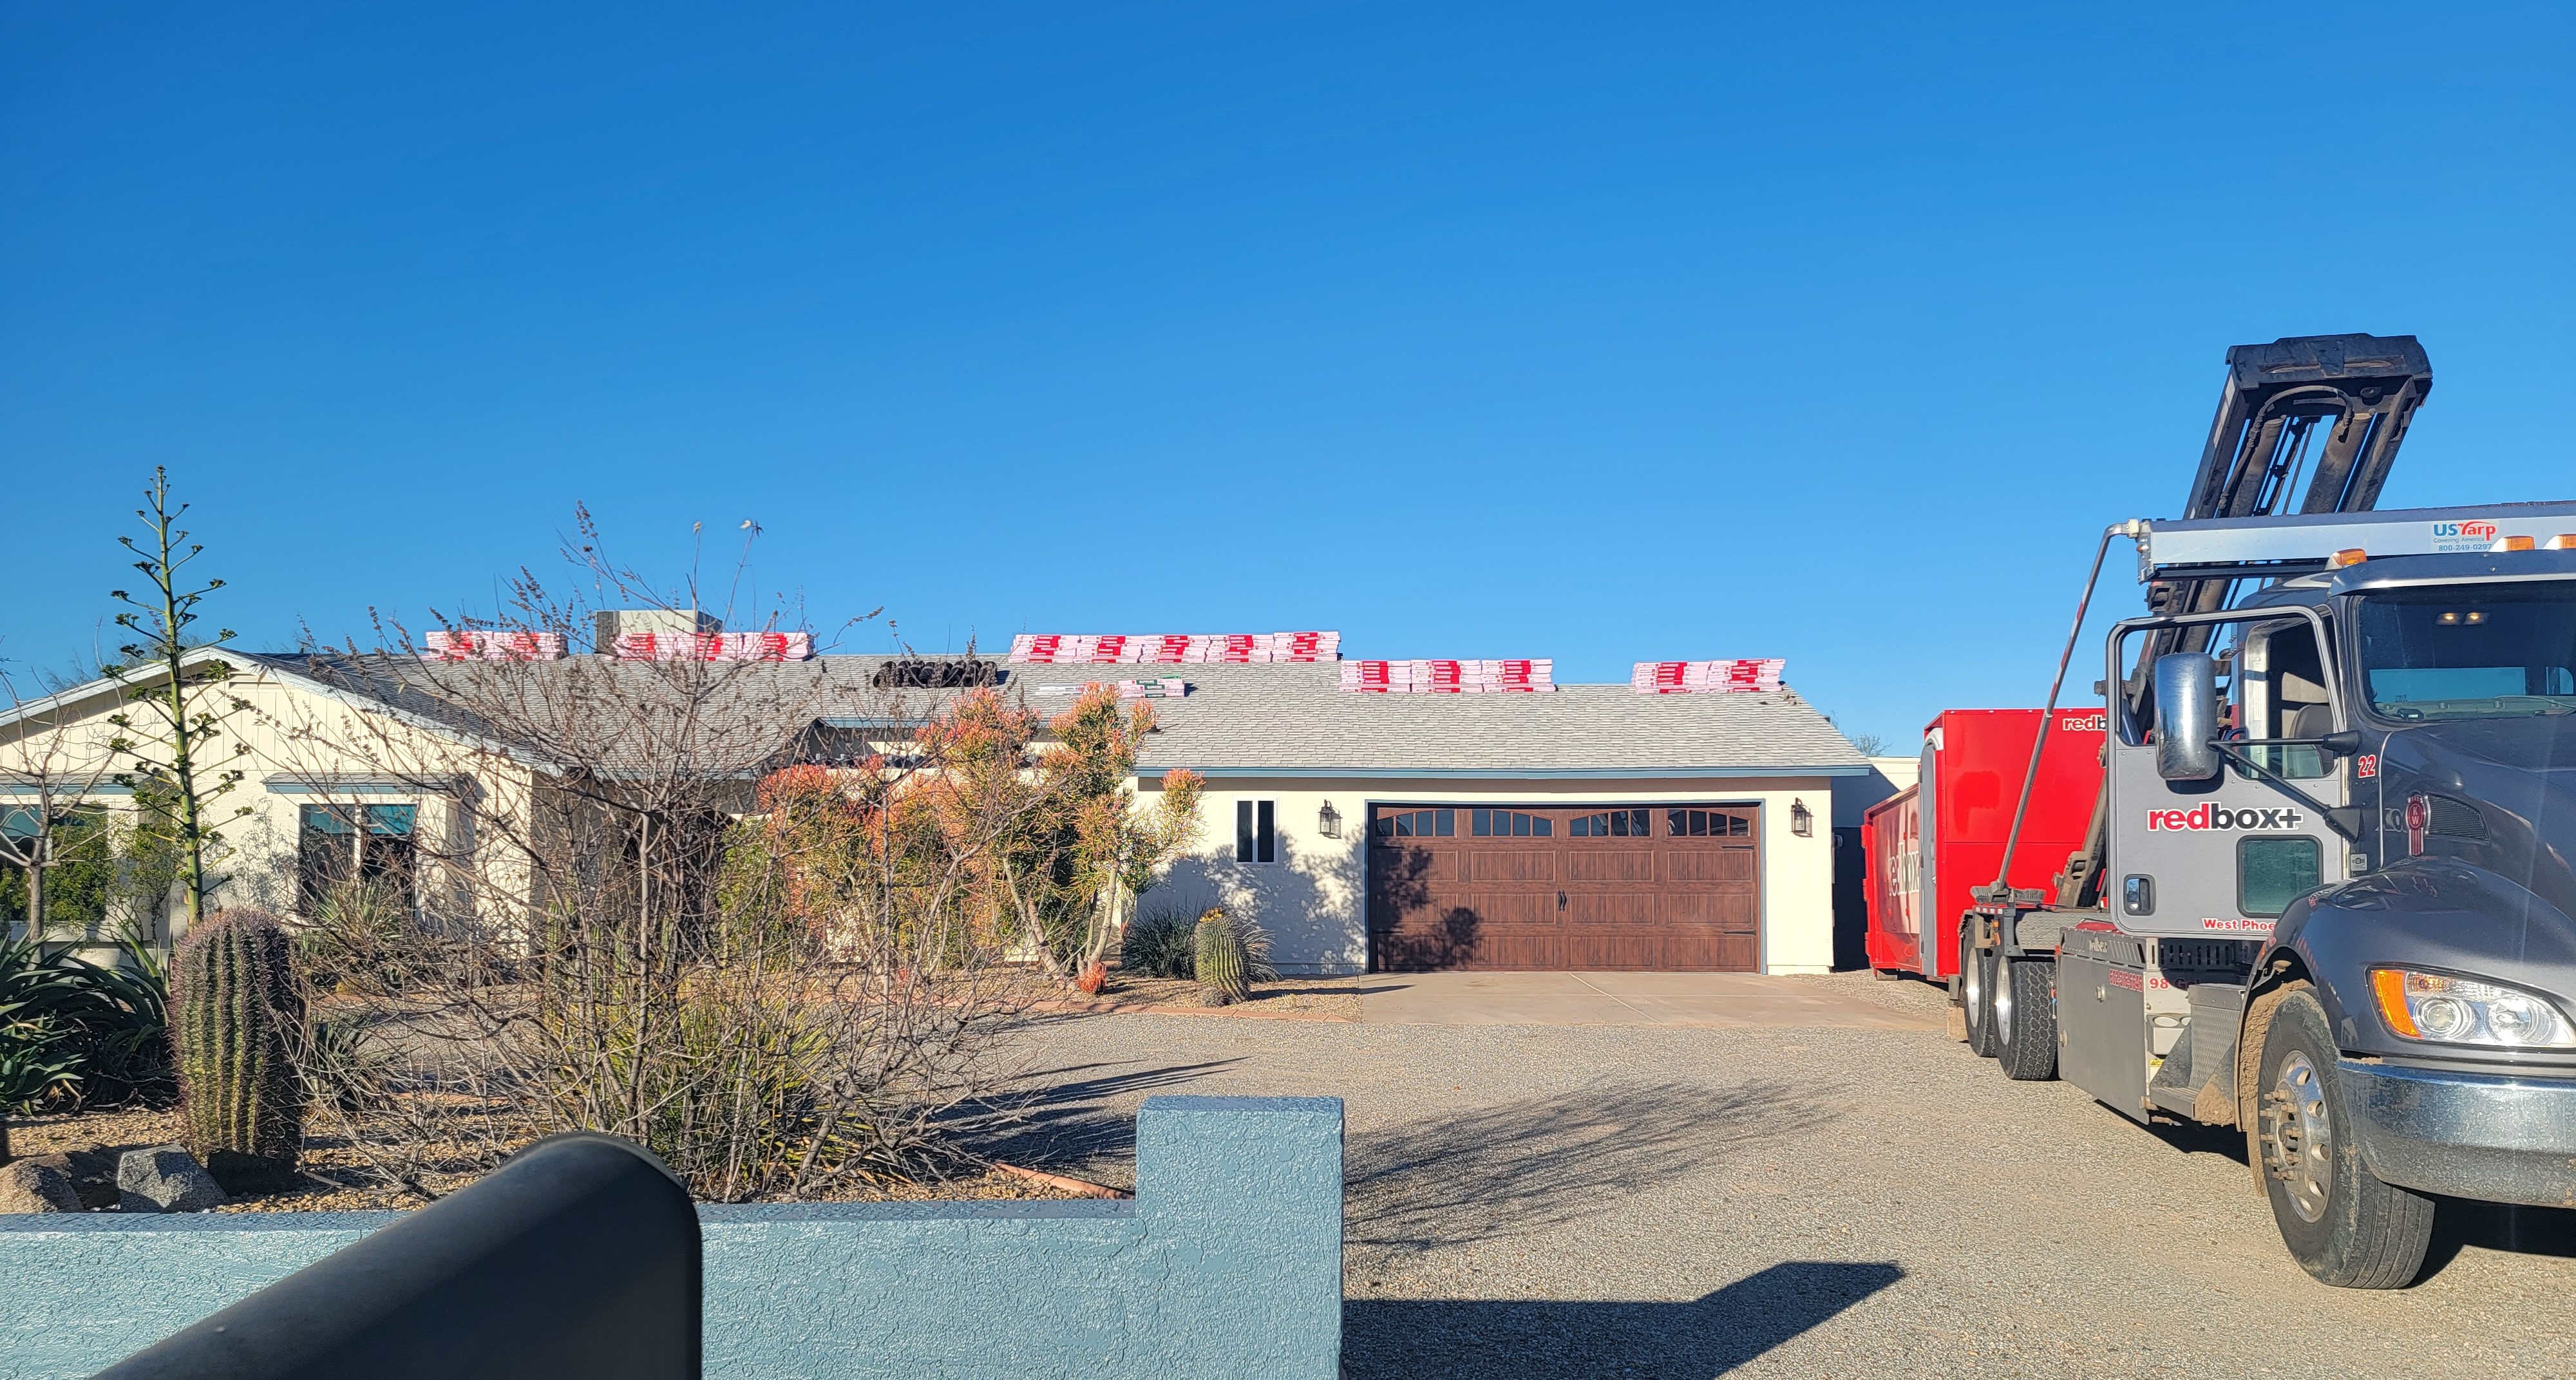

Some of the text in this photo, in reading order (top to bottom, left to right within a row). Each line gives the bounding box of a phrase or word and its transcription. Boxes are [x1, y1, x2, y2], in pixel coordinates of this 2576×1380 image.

[2358, 754, 2376, 778] 22
[2148, 802, 2303, 831] redbox+
[2202, 918, 2239, 931] West
[2149, 977, 2170, 990] 98
